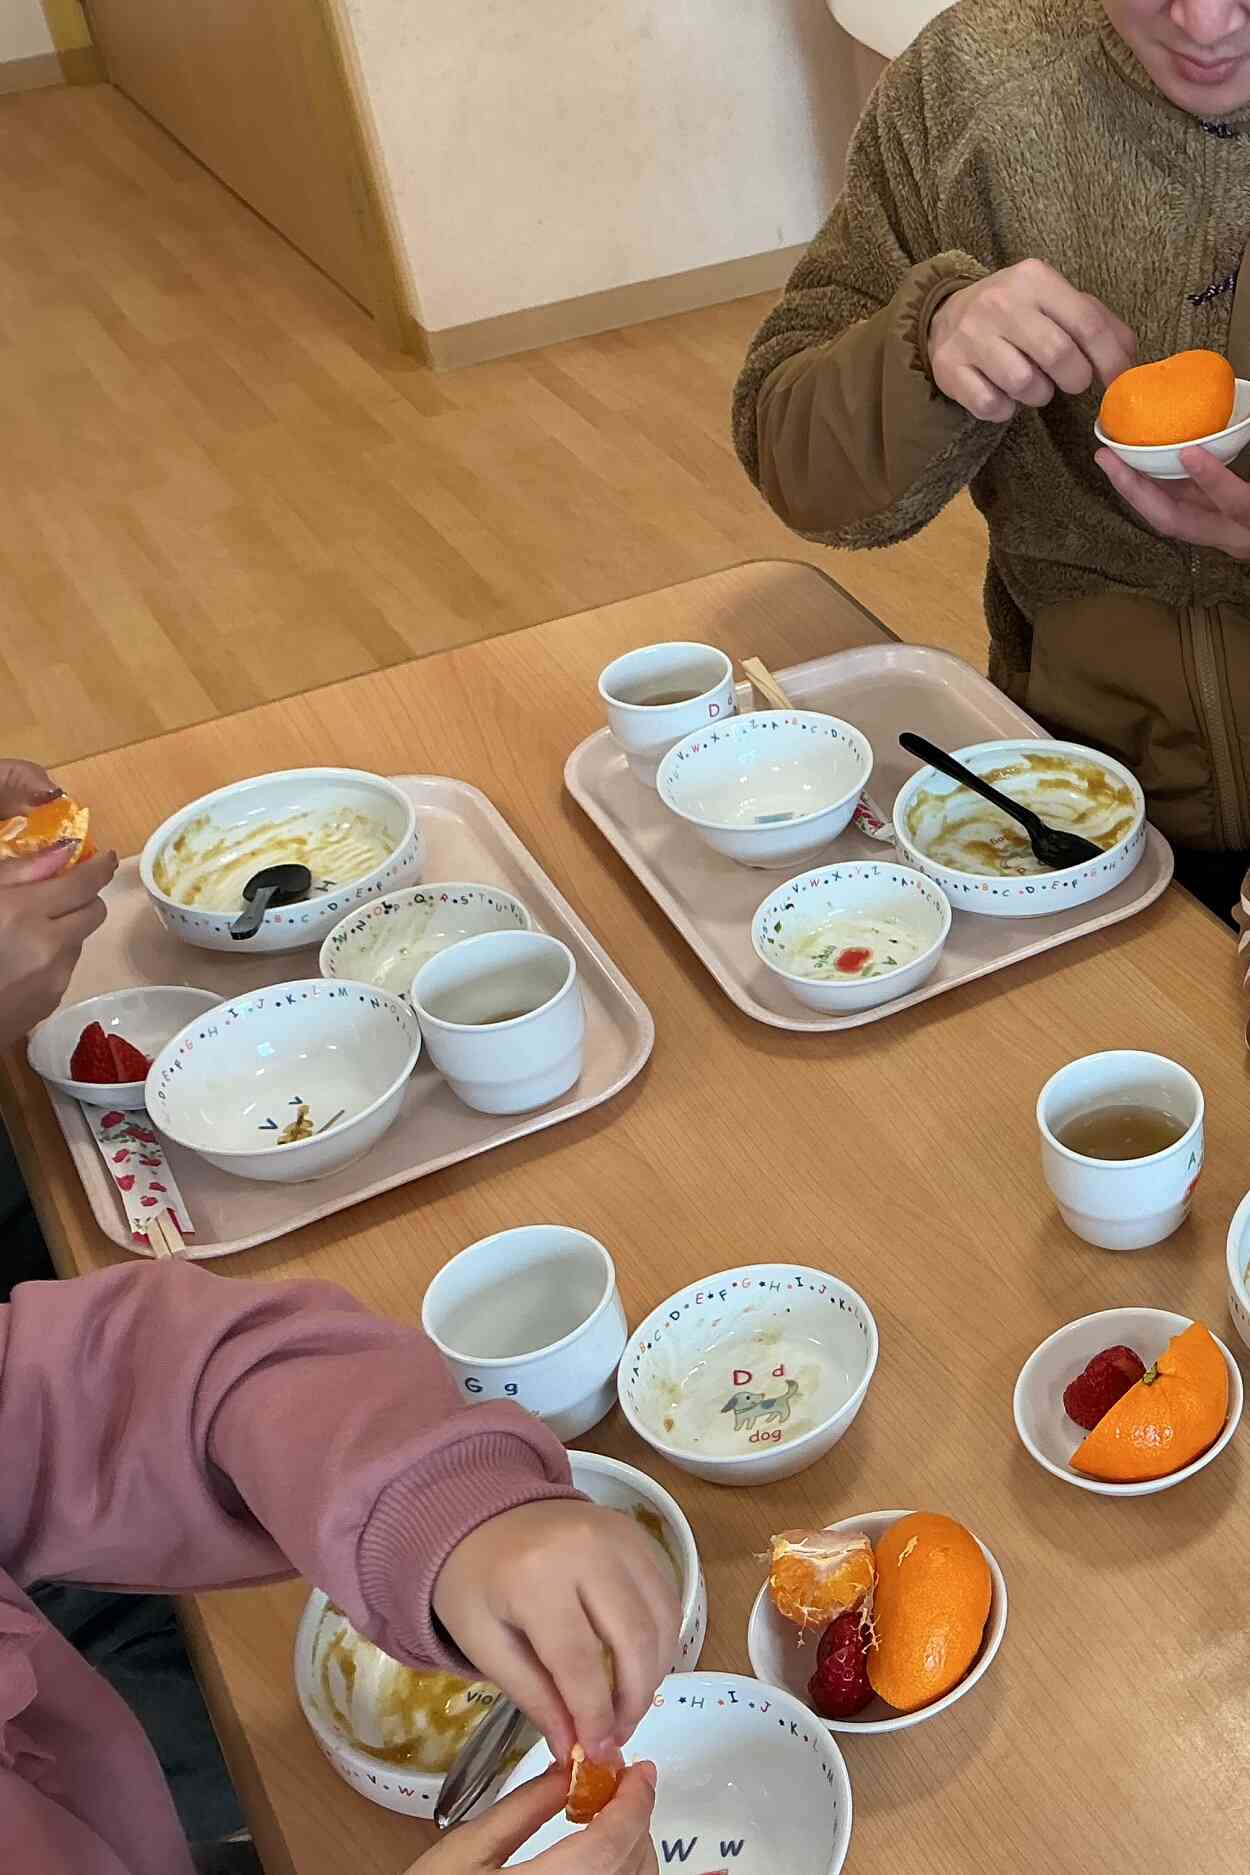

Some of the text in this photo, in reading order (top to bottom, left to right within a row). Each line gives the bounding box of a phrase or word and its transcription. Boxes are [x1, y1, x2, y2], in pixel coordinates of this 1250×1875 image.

[709, 704, 720, 717] D
[691, 743, 700, 753] W
[710, 733, 720, 744] X
[831, 729, 838, 738] D
[792, 884, 799, 893] V
[809, 879, 819, 888] W
[832, 871, 842, 881] X
[1002, 889, 1011, 897] C
[1026, 886, 1035, 894] D
[1051, 880, 1060, 890] E
[1071, 880, 1079, 888] F
[328, 902, 338, 912] D
[356, 919, 367, 931] N
[414, 893, 425, 904] Q
[461, 896, 469, 905] S
[185, 1039, 194, 1050] G
[228, 1008, 238, 1018] I
[257, 999, 264, 1009] J
[286, 995, 296, 1004] K
[338, 987, 348, 996] M
[370, 999, 380, 1009] N
[669, 1310, 680, 1321] D
[695, 1292, 704, 1304] E
[718, 1289, 729, 1301] F
[742, 1278, 752, 1289] G
[769, 1280, 781, 1292] H
[794, 1276, 804, 1287] I
[818, 1284, 827, 1294] J
[839, 1299, 846, 1310] K
[732, 1364, 785, 1386] D d
[464, 1377, 518, 1396] G g
[748, 1428, 783, 1443] dog
[466, 1690, 502, 1705] viol
[690, 1696, 705, 1709] H
[728, 1690, 739, 1703] I
[760, 1701, 772, 1712] J
[790, 1721, 799, 1737] K
[398, 1785, 415, 1797] W
[661, 1836, 745, 1864] W w
